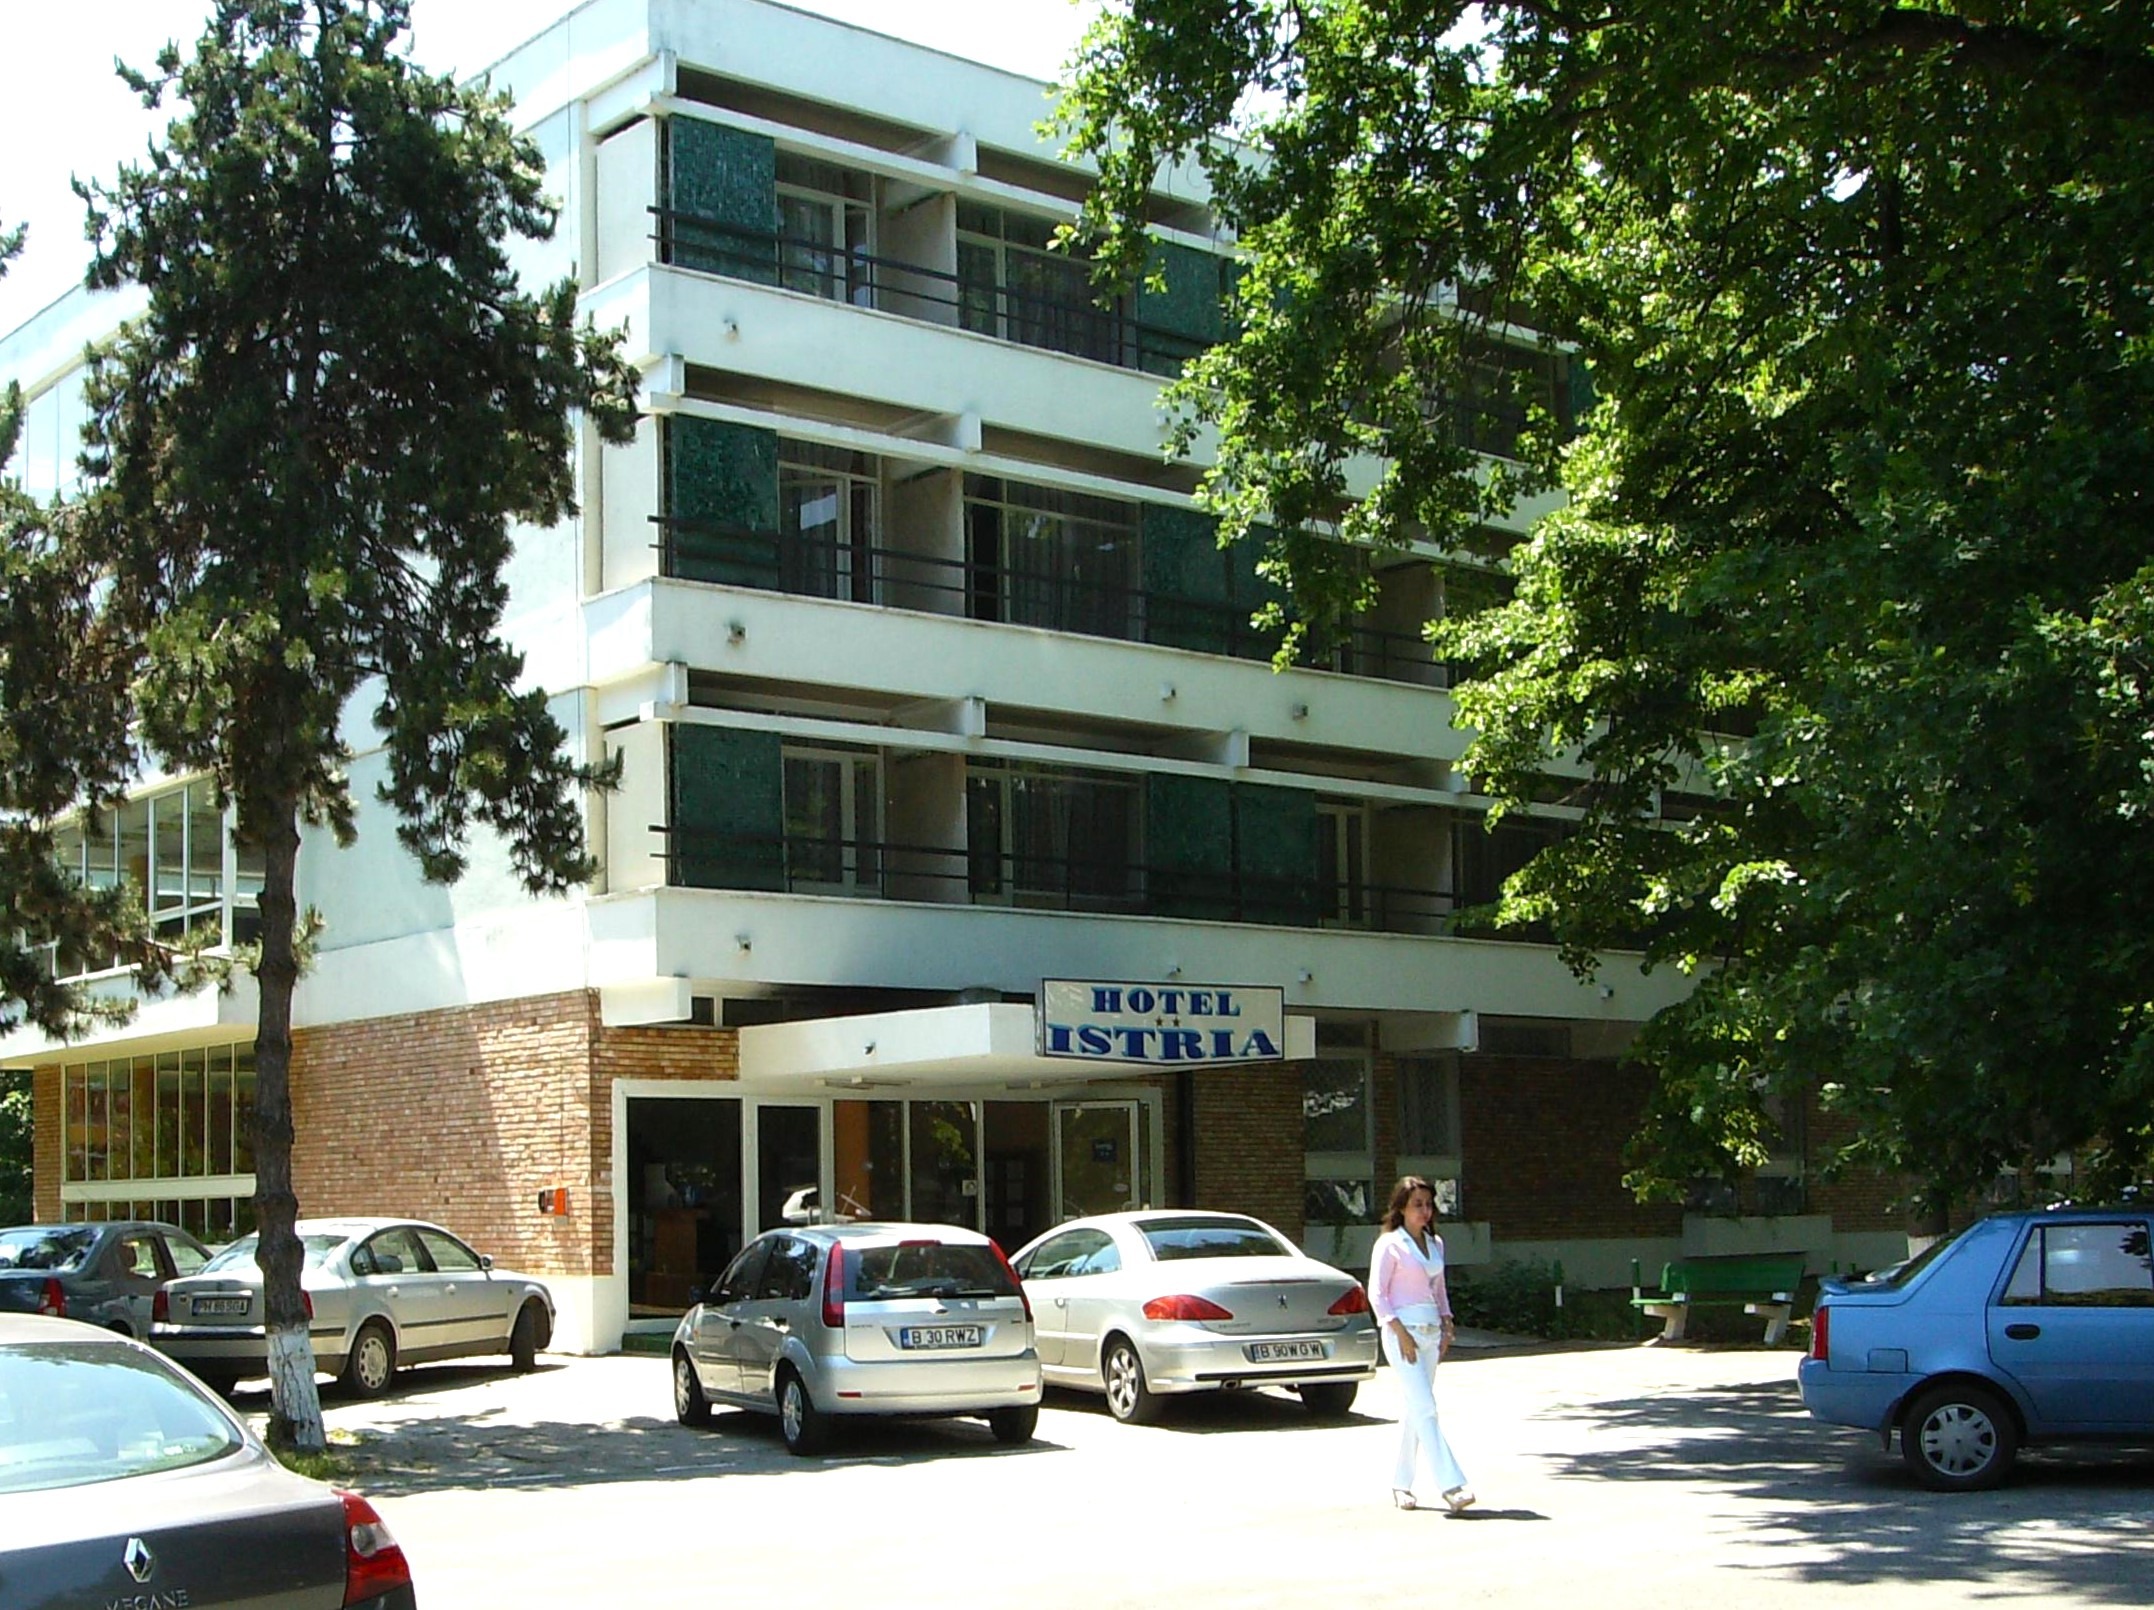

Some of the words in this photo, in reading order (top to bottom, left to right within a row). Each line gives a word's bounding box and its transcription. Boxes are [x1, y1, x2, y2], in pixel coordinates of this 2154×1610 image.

[1091, 986, 1241, 1017] HOTEL
[1048, 1023, 1279, 1060] ISTRIA
[911, 1331, 921, 1344] B
[926, 1330, 942, 1343] 30
[945, 1328, 976, 1343] RWZ
[1261, 1346, 1270, 1358] B
[1273, 1344, 1288, 1357] 90
